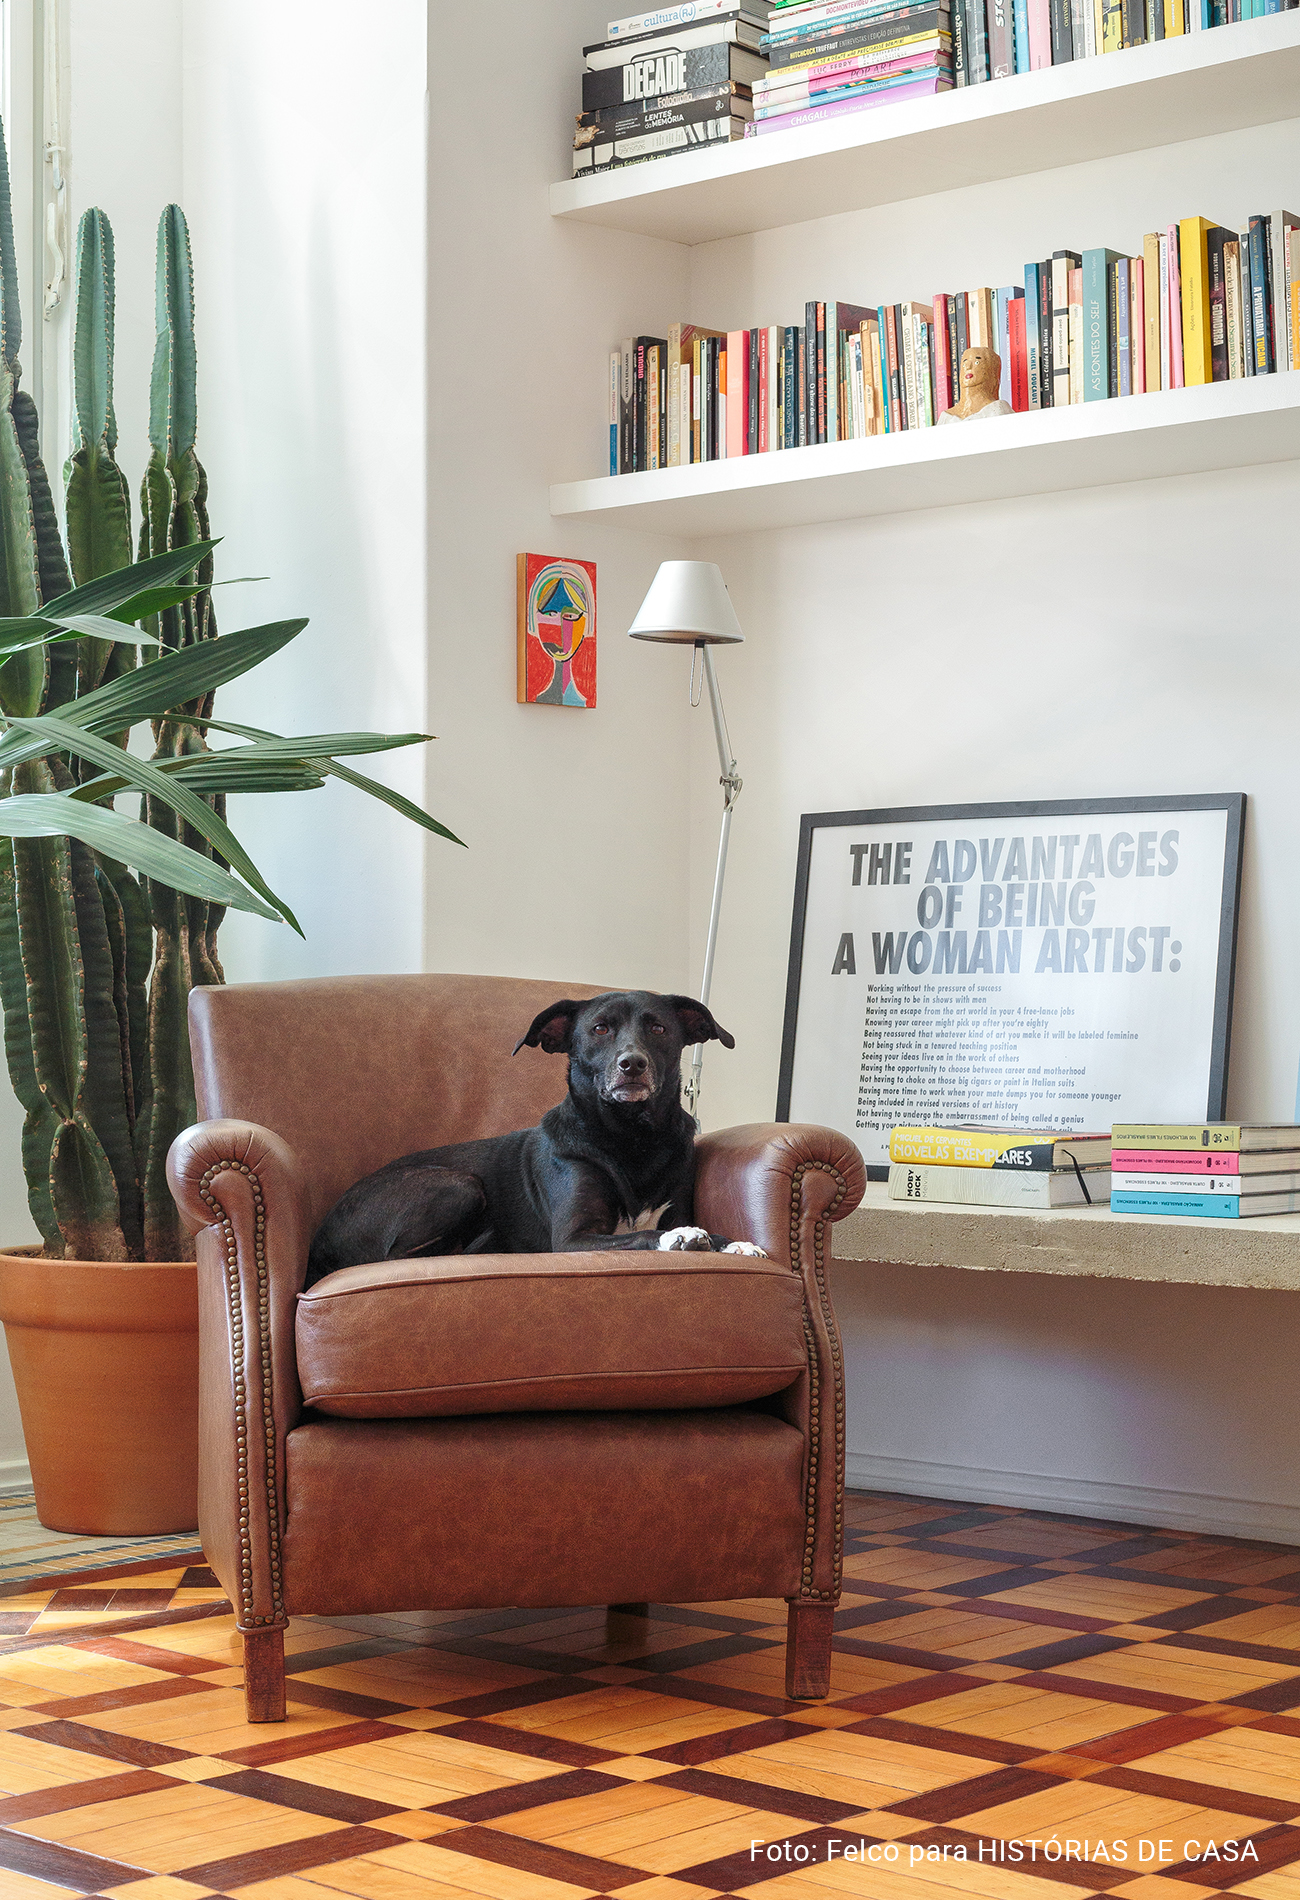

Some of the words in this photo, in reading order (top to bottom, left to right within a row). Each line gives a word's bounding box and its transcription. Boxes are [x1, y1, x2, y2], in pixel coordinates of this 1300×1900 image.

[644, 13, 679, 28] cultura
[682, 8, 693, 18] RJ
[839, 36, 867, 47] ENTREVISTAS
[886, 25, 910, 36] DEFINITIVA
[955, 14, 963, 69] Candango
[830, 60, 853, 71] FERRY
[850, 66, 872, 79] POP
[874, 62, 893, 74] ART
[623, 52, 687, 102] DECADE
[658, 92, 692, 108] Fotografia
[645, 110, 672, 121] LENTES
[790, 110, 829, 126] CHAGALL
[1091, 299, 1099, 319] SELF
[1254, 293, 1264, 336] PRIVATARIA
[1091, 322, 1100, 337] DO
[1212, 303, 1224, 346] GOMORRA
[1229, 320, 1235, 328] O
[1228, 328, 1237, 360] Segundo
[1091, 340, 1100, 375] FONTES
[1256, 337, 1266, 368] TUCANA
[672, 361, 679, 375] Os
[1091, 378, 1100, 391] AS
[672, 418, 679, 430] do
[850, 841, 913, 886] THE
[925, 829, 1180, 884] ADVANTAGES
[917, 884, 964, 930] OF
[978, 880, 1097, 928] BEING
[831, 932, 857, 975] A
[872, 929, 1023, 975] WOMAN
[1034, 926, 1183, 974] ARTIST:
[867, 984, 894, 994] Working
[896, 984, 922, 992] without
[923, 984, 936, 992] the
[937, 986, 966, 994] pressure
[968, 983, 976, 991] of
[880, 995, 902, 1005] having
[912, 995, 921, 1003] be
[922, 995, 930, 1003] in
[932, 995, 954, 1003] shows
[955, 995, 970, 1003] with
[865, 1007, 888, 1017] Having
[924, 1006, 941, 1015] from
[942, 1006, 954, 1015] the
[967, 1007, 988, 1015] world
[990, 1007, 997, 1015] in
[998, 1009, 1015, 1017] your
[1016, 1007, 1022, 1015] 4
[1023, 1007, 1059, 1015] free-lance
[1060, 1007, 1075, 1017] jobs
[864, 1018, 893, 1028] Knowing
[894, 1020, 910, 1028] your
[935, 1018, 955, 1029] might
[956, 1018, 970, 1029] pick
[982, 1018, 1000, 1027] after
[1001, 1019, 1025, 1029] you're
[1026, 1019, 1049, 1029] eighty
[864, 1029, 882, 1039] Being
[884, 1029, 916, 1037] reassured
[918, 1029, 933, 1038] that
[936, 1030, 966, 1038] whatever
[969, 1030, 984, 1038] kind
[986, 1030, 993, 1038] of
[1008, 1033, 1020, 1041] you
[1023, 1030, 1041, 1039] make
[1044, 1030, 1049, 1039] it
[1052, 1030, 1065, 1039] will
[1067, 1030, 1076, 1039] be
[1078, 1031, 1104, 1039] labeled
[1107, 1031, 1139, 1039] feminine
[862, 1041, 875, 1049] Not
[876, 1040, 894, 1051] being
[896, 1041, 913, 1049] stuck
[914, 1041, 922, 1049] in
[930, 1041, 957, 1050] tenured
[958, 1041, 988, 1052] teaching
[989, 1042, 1018, 1053] position
[861, 1052, 883, 1062] Seeing
[884, 1054, 899, 1062] your
[901, 1052, 920, 1060] ideas
[921, 1053, 935, 1061] live
[946, 1053, 954, 1061] in
[955, 1053, 967, 1061] the
[967, 1053, 987, 1061] work
[988, 1054, 996, 1062] of
[997, 1054, 1020, 1062] others
[895, 1133, 923, 1143] MIGUEL
[924, 1135, 934, 1143] DE
[935, 1136, 972, 1146] CERVANTES
[894, 1144, 949, 1159] NOVELAS
[954, 1148, 1032, 1166] EXEMPLARES
[907, 1169, 915, 1197] MOBY
